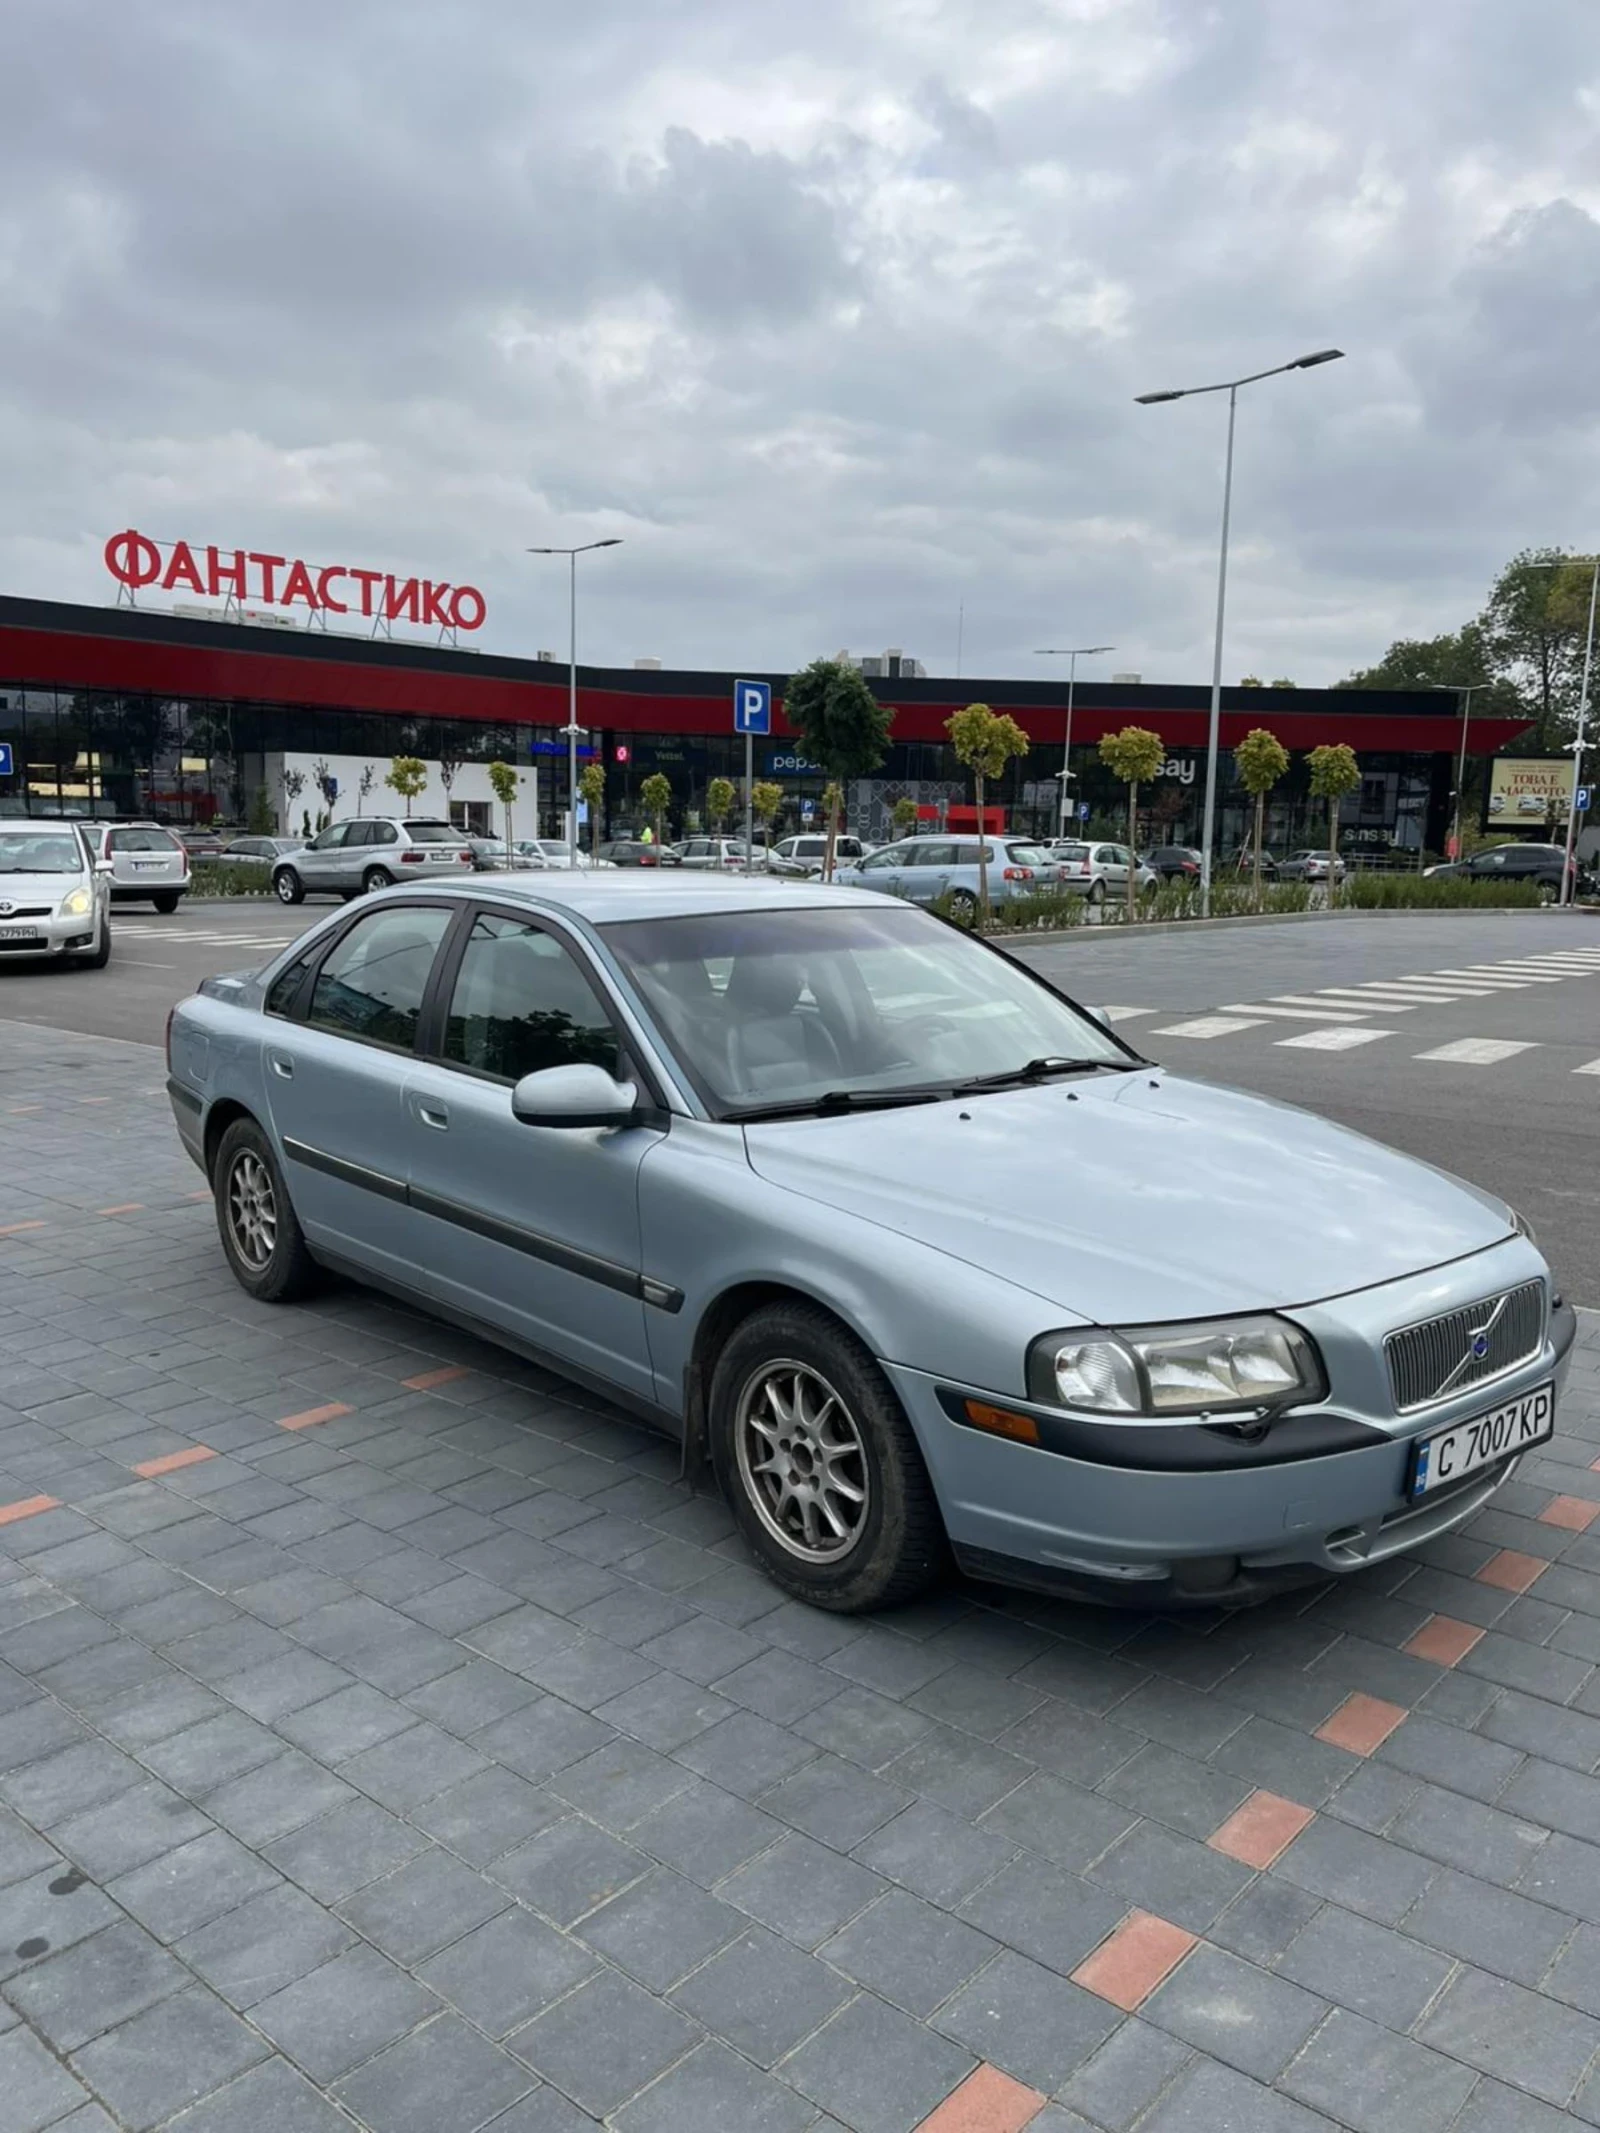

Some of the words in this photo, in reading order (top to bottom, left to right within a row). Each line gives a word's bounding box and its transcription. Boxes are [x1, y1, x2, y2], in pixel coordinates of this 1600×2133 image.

[105, 529, 487, 630] ФАНТАСТИКО
[744, 689, 763, 726] P
[1577, 789, 1587, 807] P
[1344, 825, 1399, 847] sinsay
